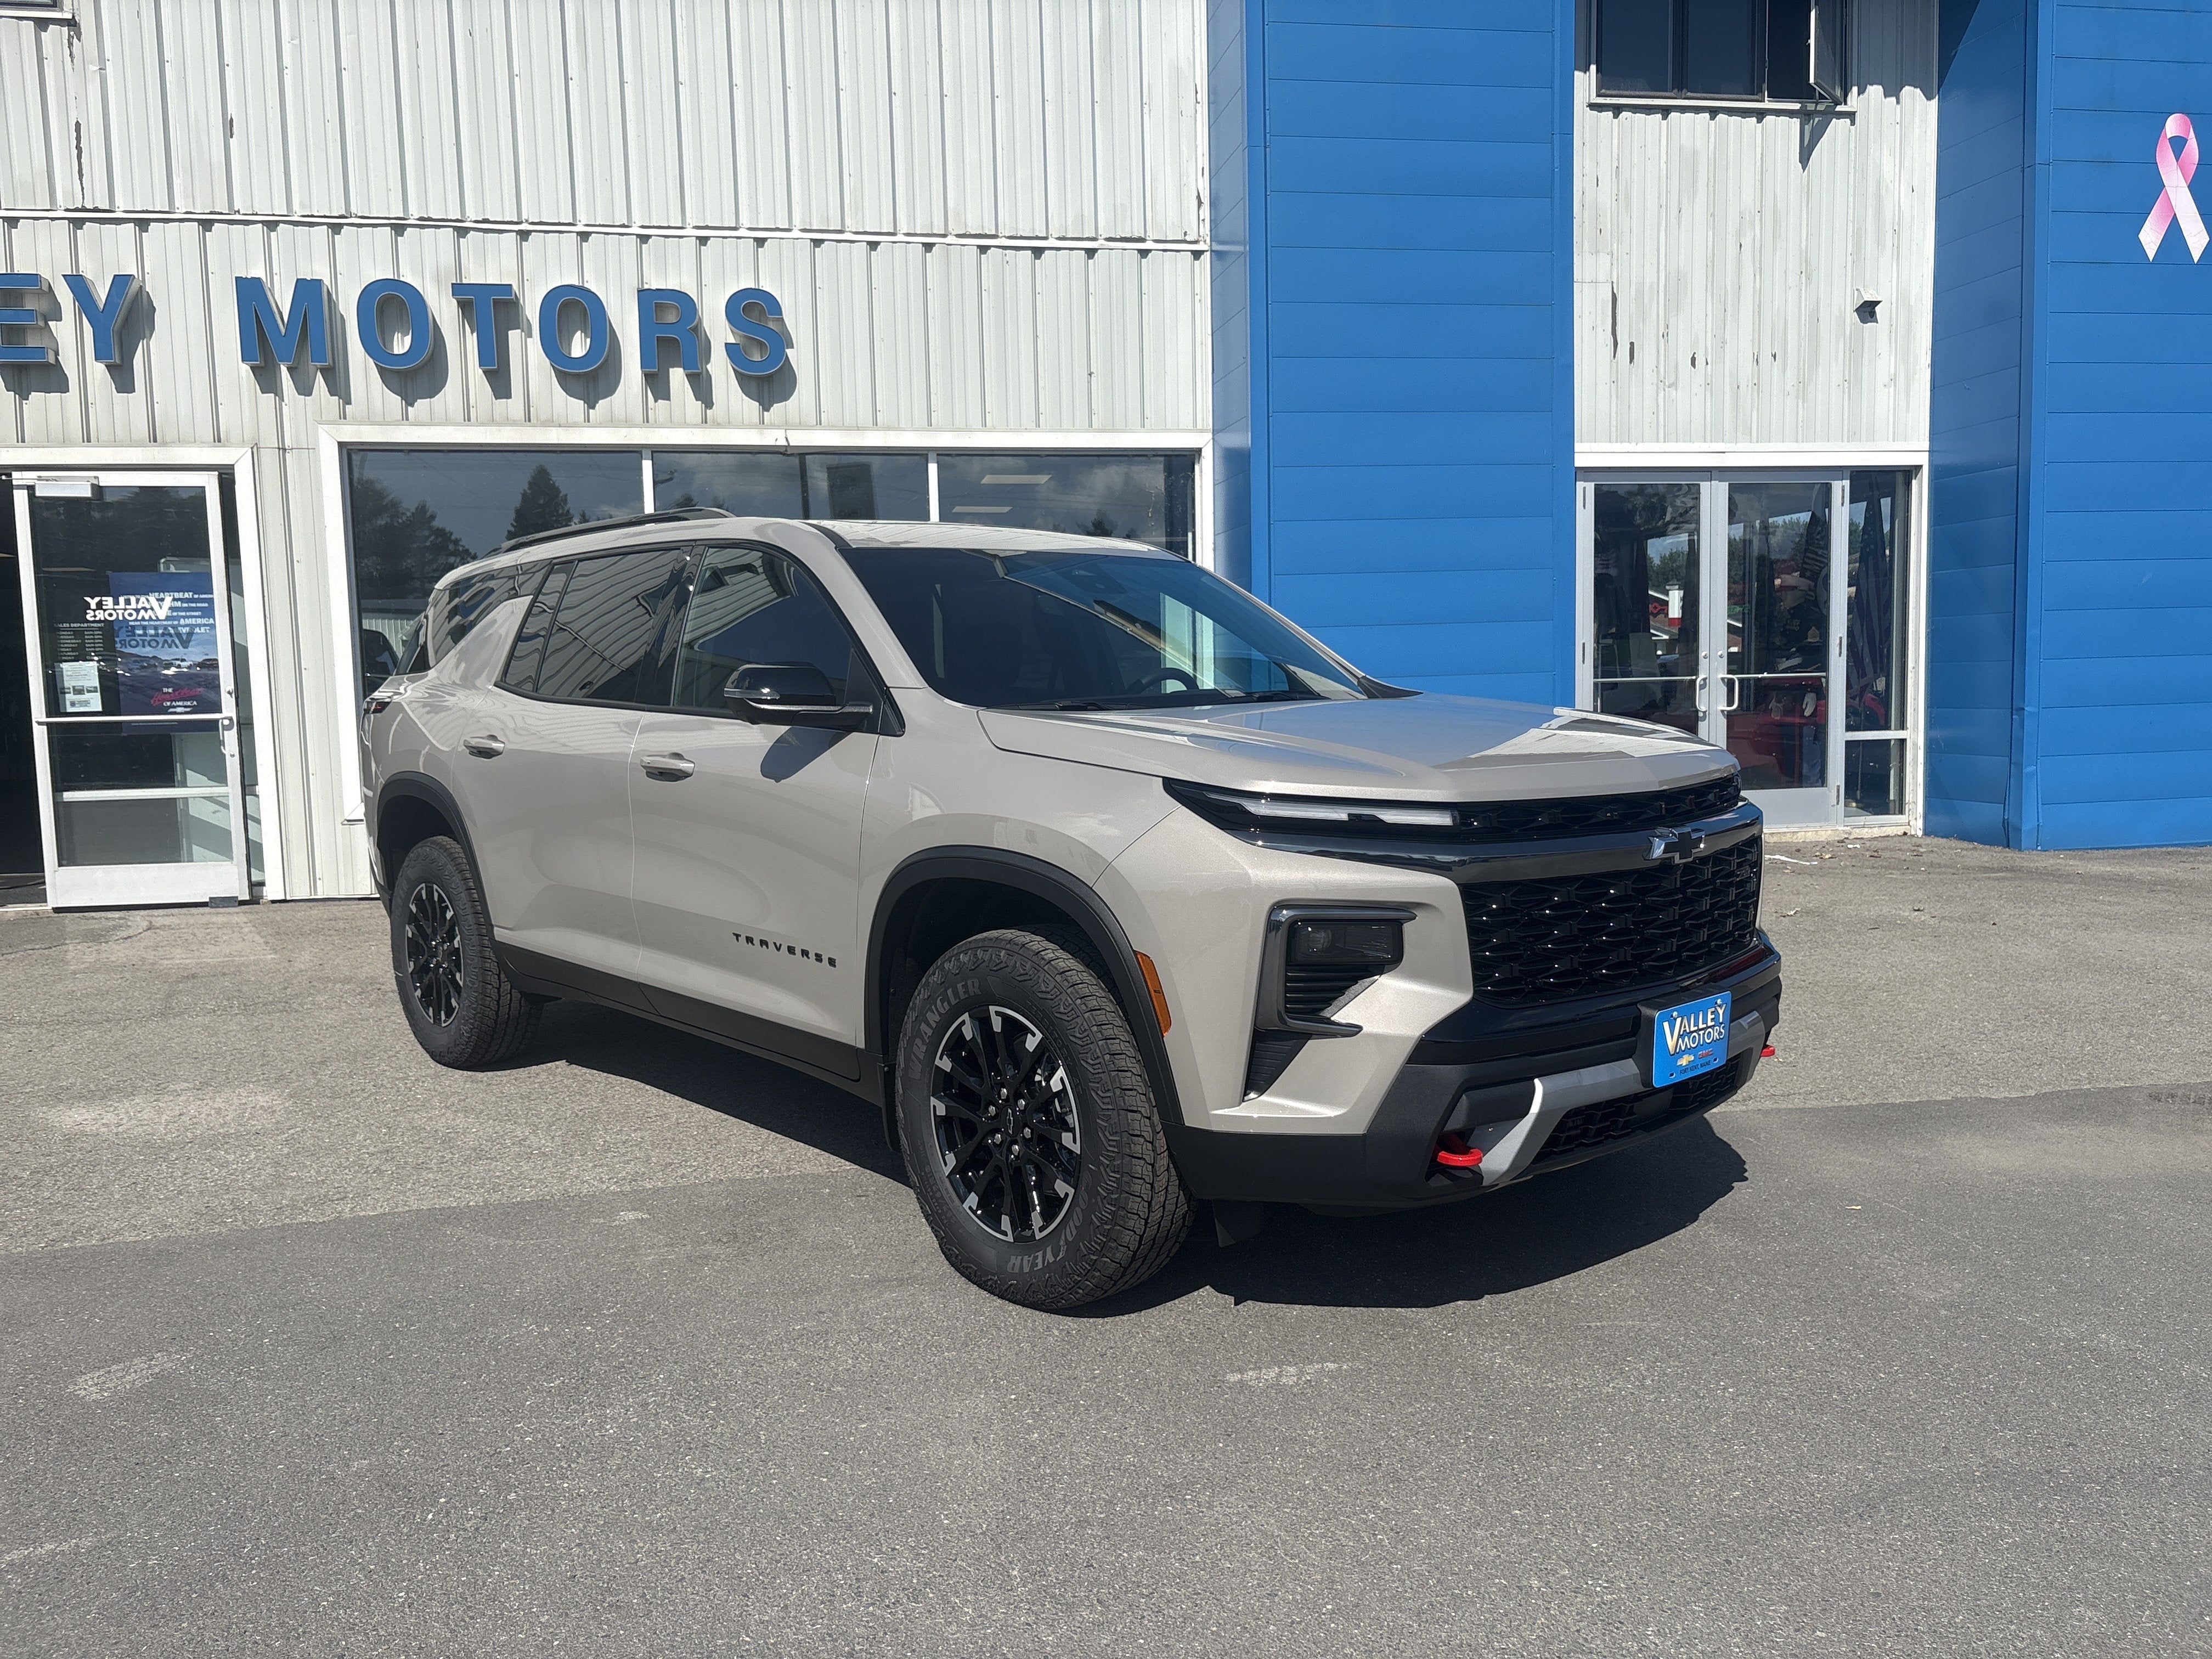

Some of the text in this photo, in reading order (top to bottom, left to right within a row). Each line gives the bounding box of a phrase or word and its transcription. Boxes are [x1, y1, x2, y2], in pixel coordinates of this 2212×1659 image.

[235, 276, 788, 376] MOTORS
[732, 932, 837, 968] TRAVERSE
[908, 978, 982, 1080] WRANGLER
[1662, 1003, 1727, 1056] VALLEY
[1675, 1023, 1725, 1053] MOTORS
